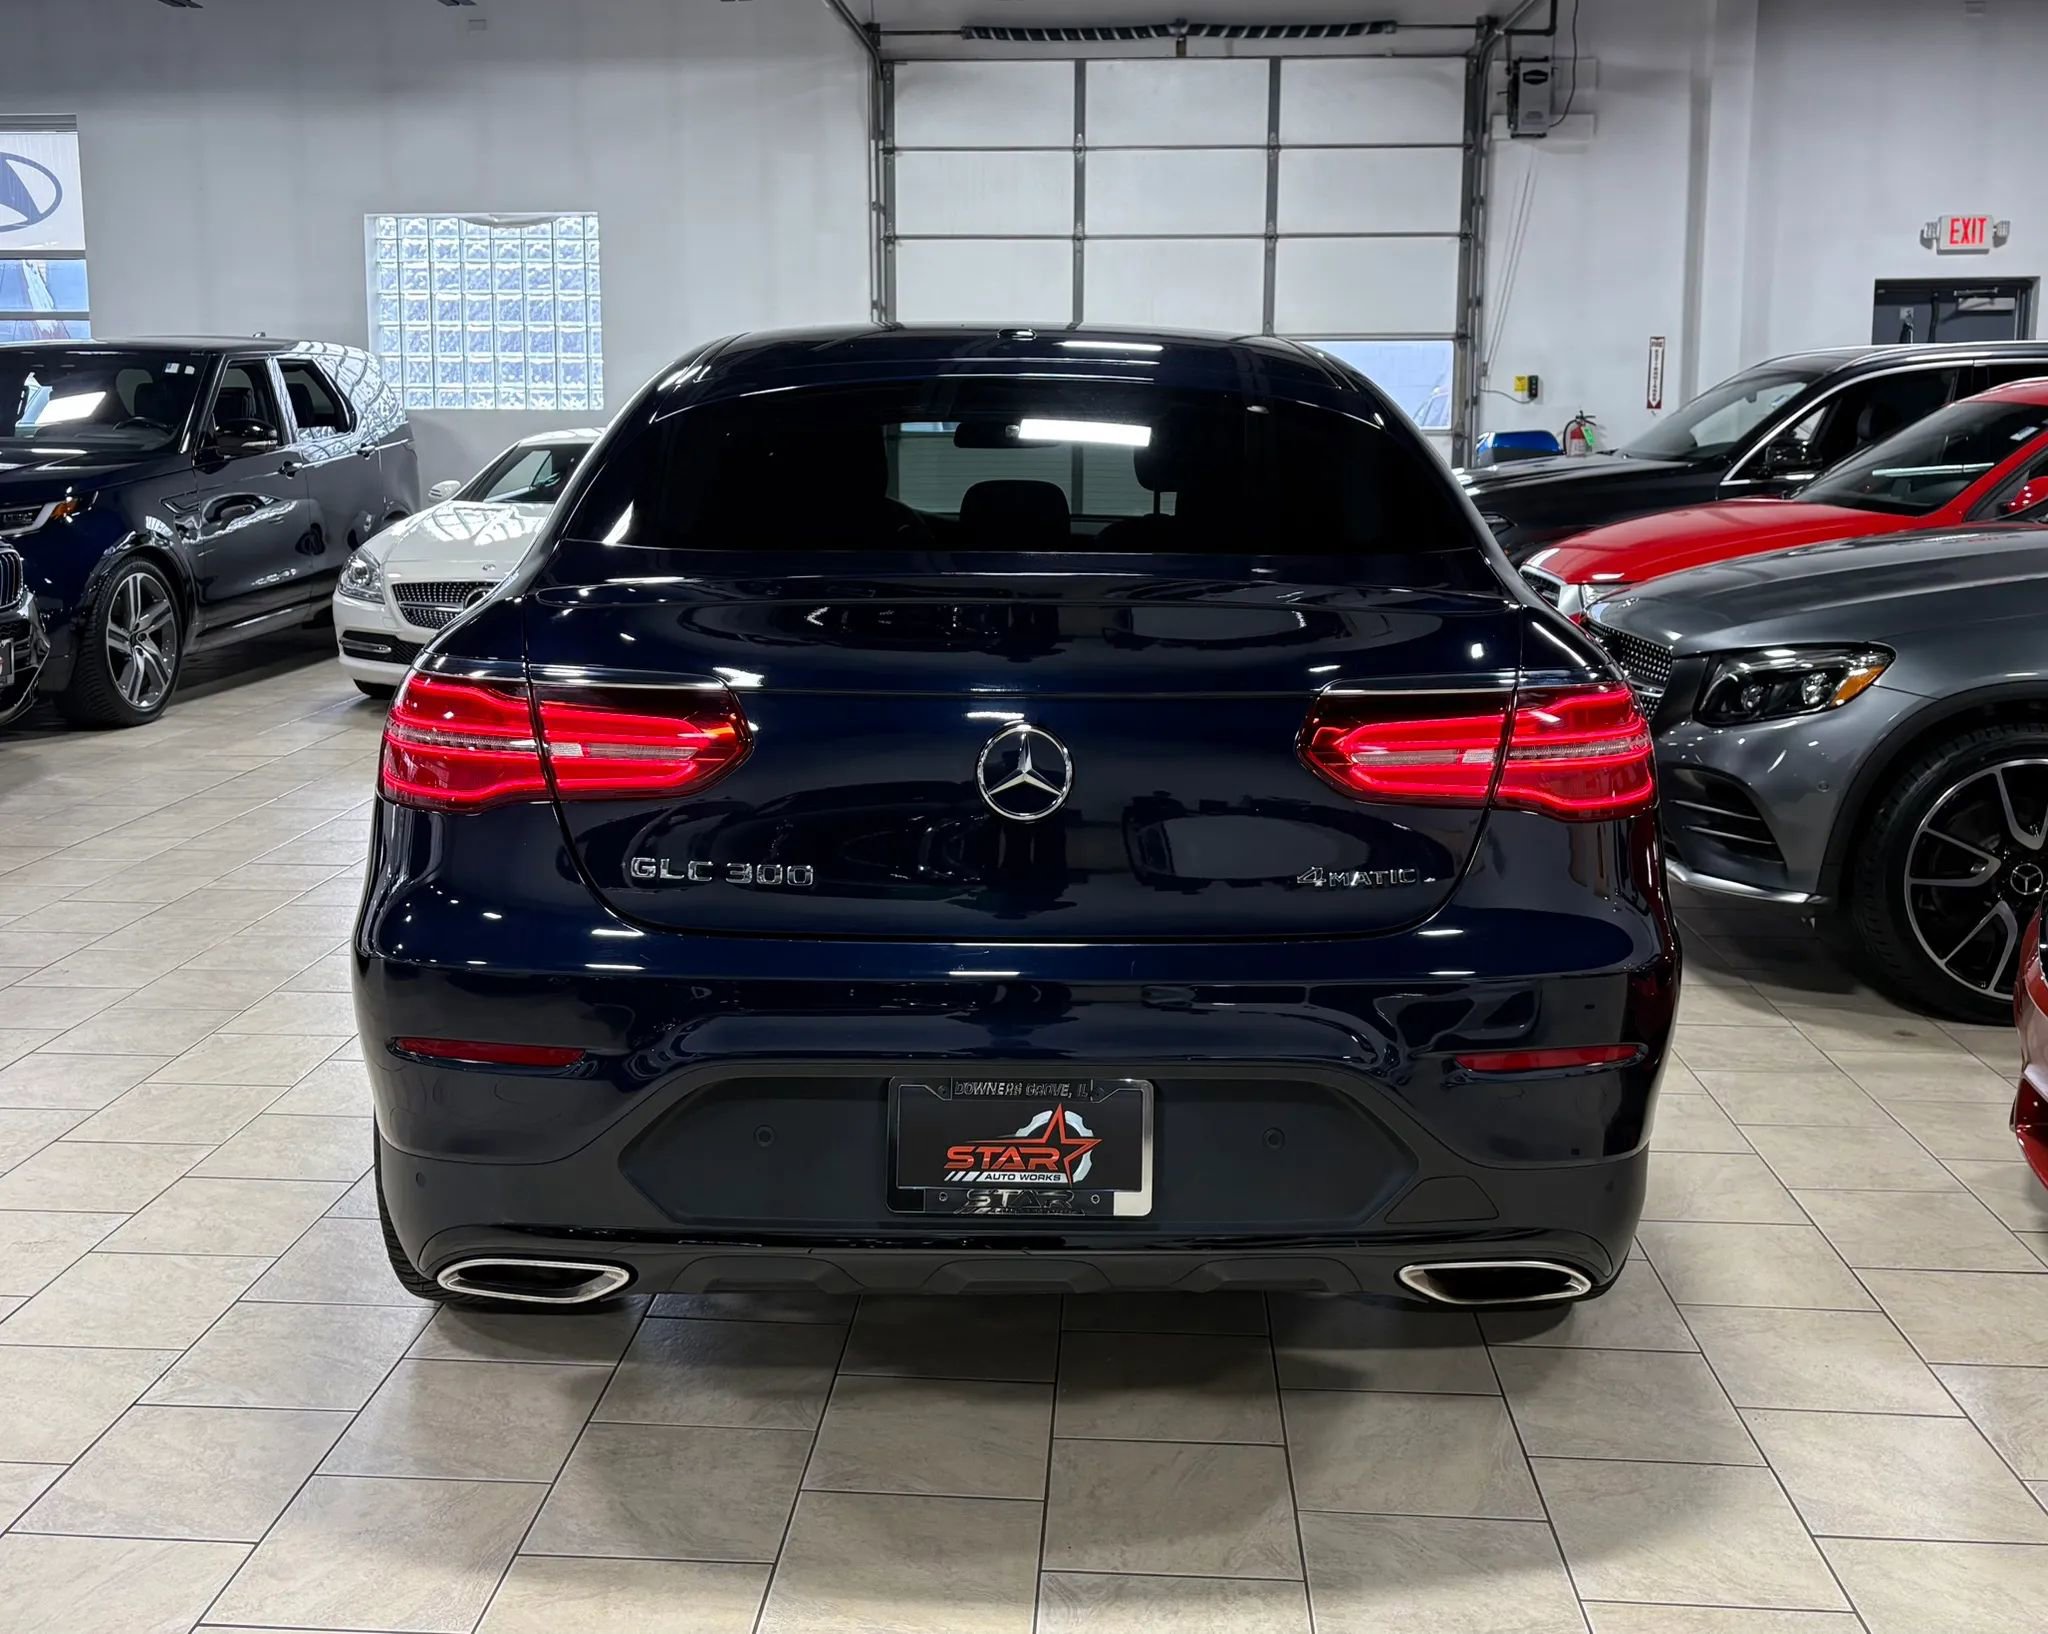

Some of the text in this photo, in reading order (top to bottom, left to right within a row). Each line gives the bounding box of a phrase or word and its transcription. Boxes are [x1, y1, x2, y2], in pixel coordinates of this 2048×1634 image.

[1949, 217, 1987, 245] EXIT
[630, 856, 814, 887] GLC 300
[1296, 866, 1416, 887] 4MATIC
[954, 1081, 1023, 1096] DOWNERS
[943, 1146, 1060, 1171] STAR
[984, 1173, 1061, 1182] AUTO WORKS
[963, 1188, 1075, 1208] STAR
